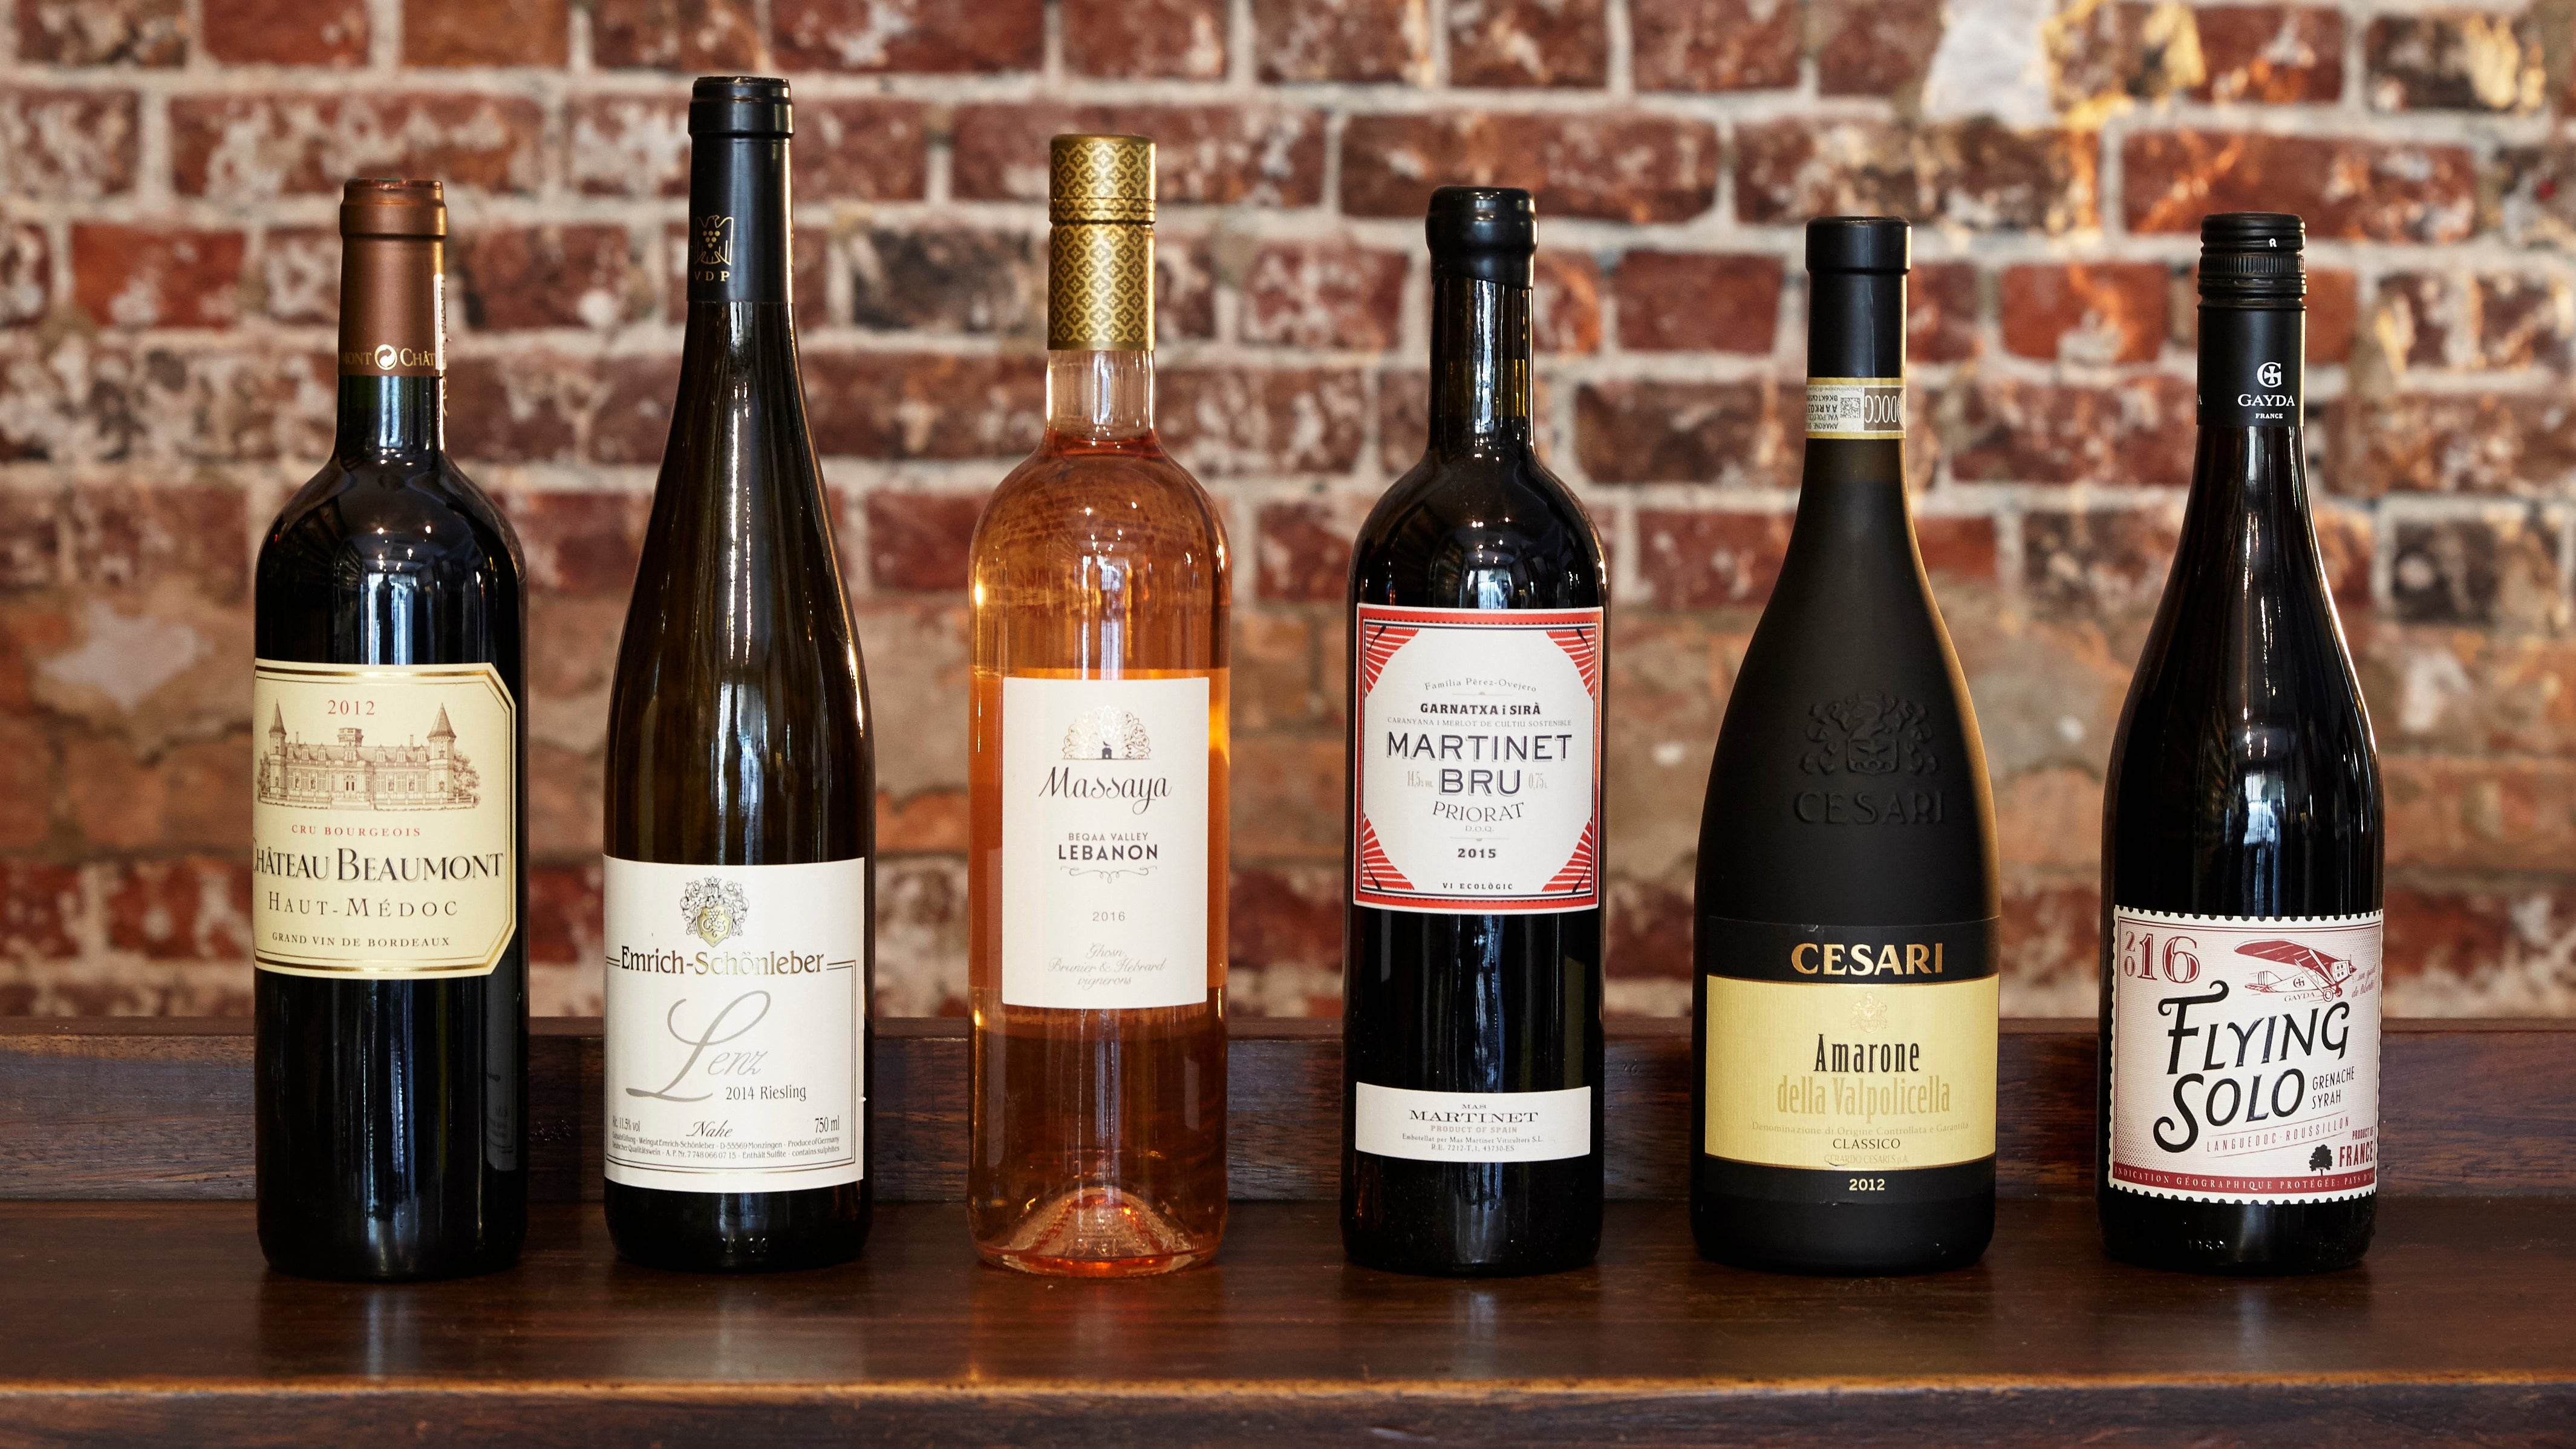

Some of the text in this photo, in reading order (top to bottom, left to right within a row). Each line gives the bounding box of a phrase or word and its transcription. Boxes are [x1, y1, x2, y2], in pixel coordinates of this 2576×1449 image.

[2238, 394, 2295, 407] GAYDA
[328, 699, 376, 716] 2012
[1420, 703, 1498, 715] GARNATXA
[1510, 702, 1541, 715] SIRÀ
[1386, 731, 1572, 762] MARTINET
[1038, 765, 1172, 816] Massaya
[1439, 768, 1521, 797] BRU
[1432, 800, 1524, 822] PRIORAT
[1794, 790, 1945, 825] CESARI
[292, 824, 420, 837] CRU BOURGEOIS
[1068, 831, 1148, 842] BEQAA VALLEY
[1058, 843, 1158, 862] LEBANON
[1458, 848, 1496, 859] 2015
[337, 848, 504, 882] BEAUMONT
[1460, 882, 1513, 890] ECOLÒGIC
[269, 891, 458, 917] HAUT-MÉDOC
[1092, 911, 1126, 922] 2016
[272, 932, 450, 947] GRAND VIN DE BORDEAUX
[622, 946, 824, 976] Emrich-Schönleber
[1792, 942, 1943, 976] CESARI
[2284, 992, 2315, 1002] GAYDA
[2158, 980, 2350, 1075] FLYING
[625, 990, 771, 1102] Lenz
[1813, 1033, 1920, 1073] Amarone
[2312, 1066, 2355, 1091] GRENACHE
[726, 1085, 807, 1102] 2014 Riesling
[1777, 1074, 1951, 1124] della Valpolicella
[2312, 1090, 2341, 1110] SYRAH
[1409, 1110, 1538, 1123] MARTINET
[2153, 1068, 2305, 1154] SOLO
[686, 1120, 733, 1137] Nahe
[815, 1115, 840, 1133] 750 ml
[1431, 1124, 1472, 1133] PRODUCT
[1752, 1121, 1821, 1135] Denominazione
[1825, 1127, 1833, 1135] di
[1837, 1127, 1873, 1137] Origine
[1877, 1125, 1926, 1136] Controllata
[1403, 1133, 1435, 1142] Embotellat
[2352, 1127, 2370, 1140] PRODUCT
[748, 1142, 782, 1150] Monzingen
[788, 1139, 811, 1148] Produce
[1833, 1137, 1900, 1150] CLASSICO
[1864, 1154, 1890, 1164] CESARI
[2340, 1141, 2373, 1167] FRANCE
[1849, 1178, 1885, 1191] 2012
[2115, 1166, 2169, 1183] INDICATION
[2177, 1176, 2272, 1191] GÉOGRAPHIQUE
